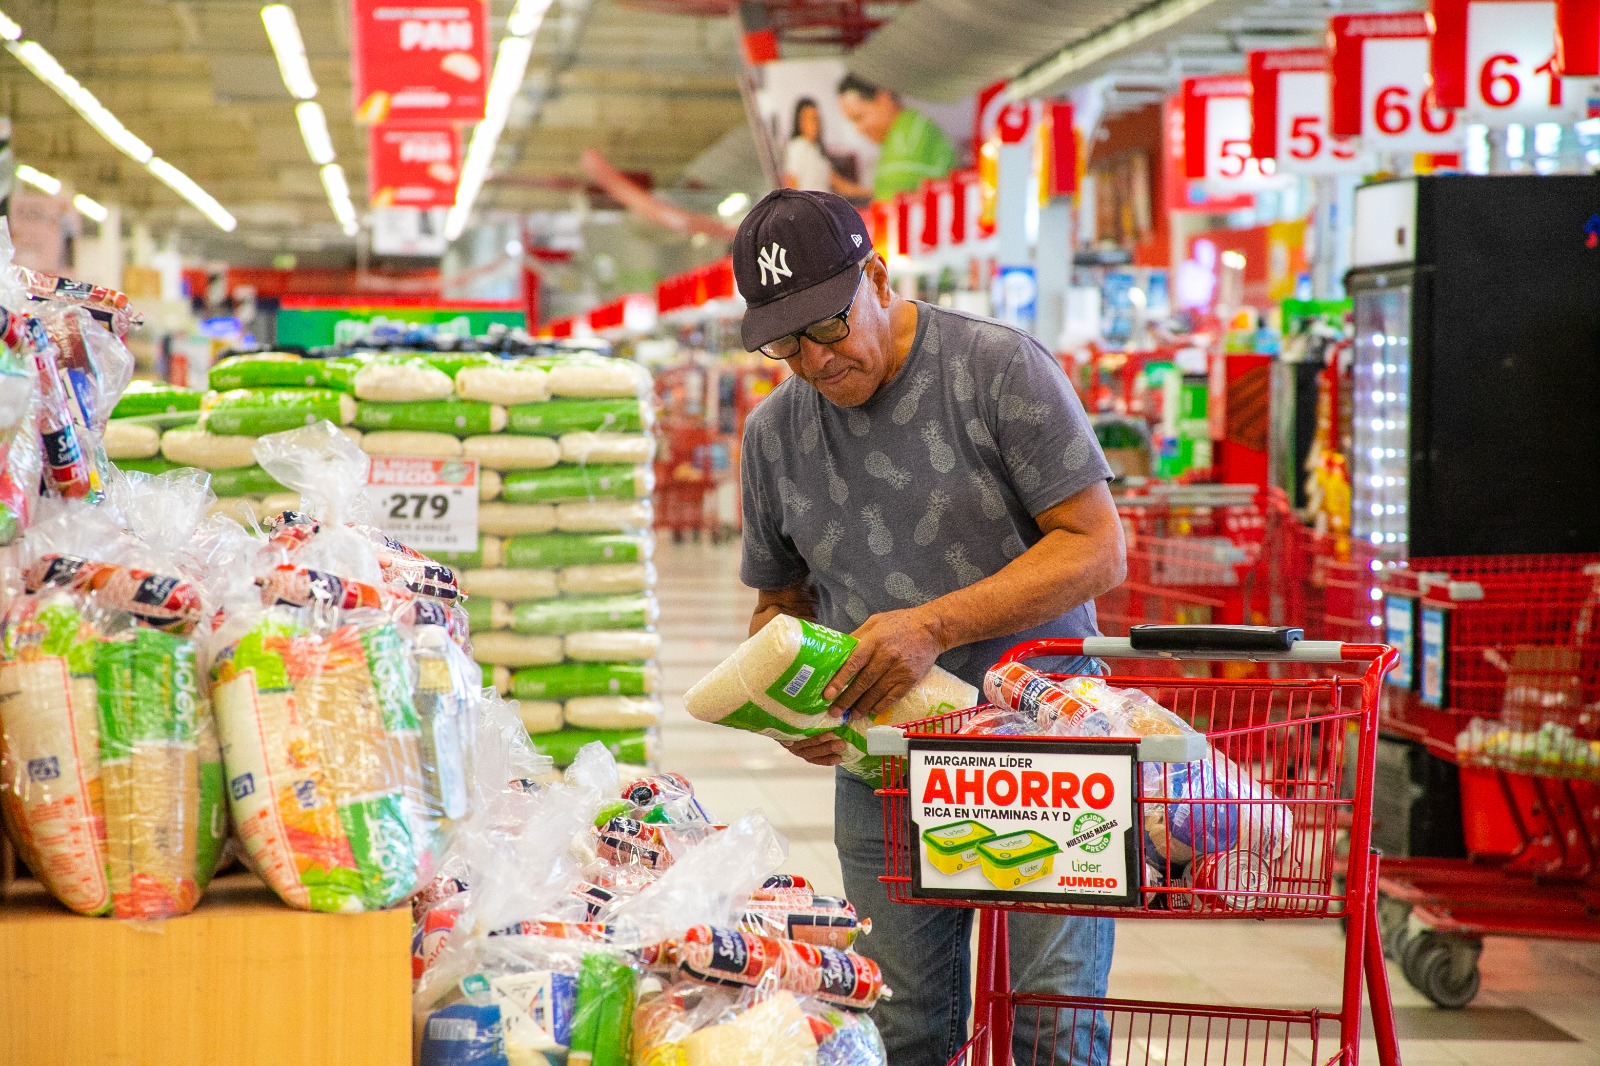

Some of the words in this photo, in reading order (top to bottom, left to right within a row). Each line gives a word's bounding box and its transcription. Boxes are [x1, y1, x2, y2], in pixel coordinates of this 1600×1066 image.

[401, 22, 474, 50] PAN
[1479, 54, 1562, 107] 61
[757, 242, 793, 286] NY
[389, 494, 448, 519] 279
[924, 755, 997, 768] MARGARINA
[999, 755, 1033, 768] LÍDER
[922, 768, 1115, 810] AHORRO
[924, 807, 952, 818] RICA
[954, 808, 970, 819] EN
[972, 808, 1038, 821] VITAMINAS
[1041, 811, 1050, 821] A
[1052, 811, 1060, 822] Y
[1063, 812, 1071, 822] D
[1080, 814, 1102, 824] MEJOR
[1066, 830, 1095, 849] NUESTRAS
[1094, 819, 1119, 836] MARCAS
[1085, 838, 1109, 853] PRECIO
[1057, 876, 1118, 889] JUMBO
